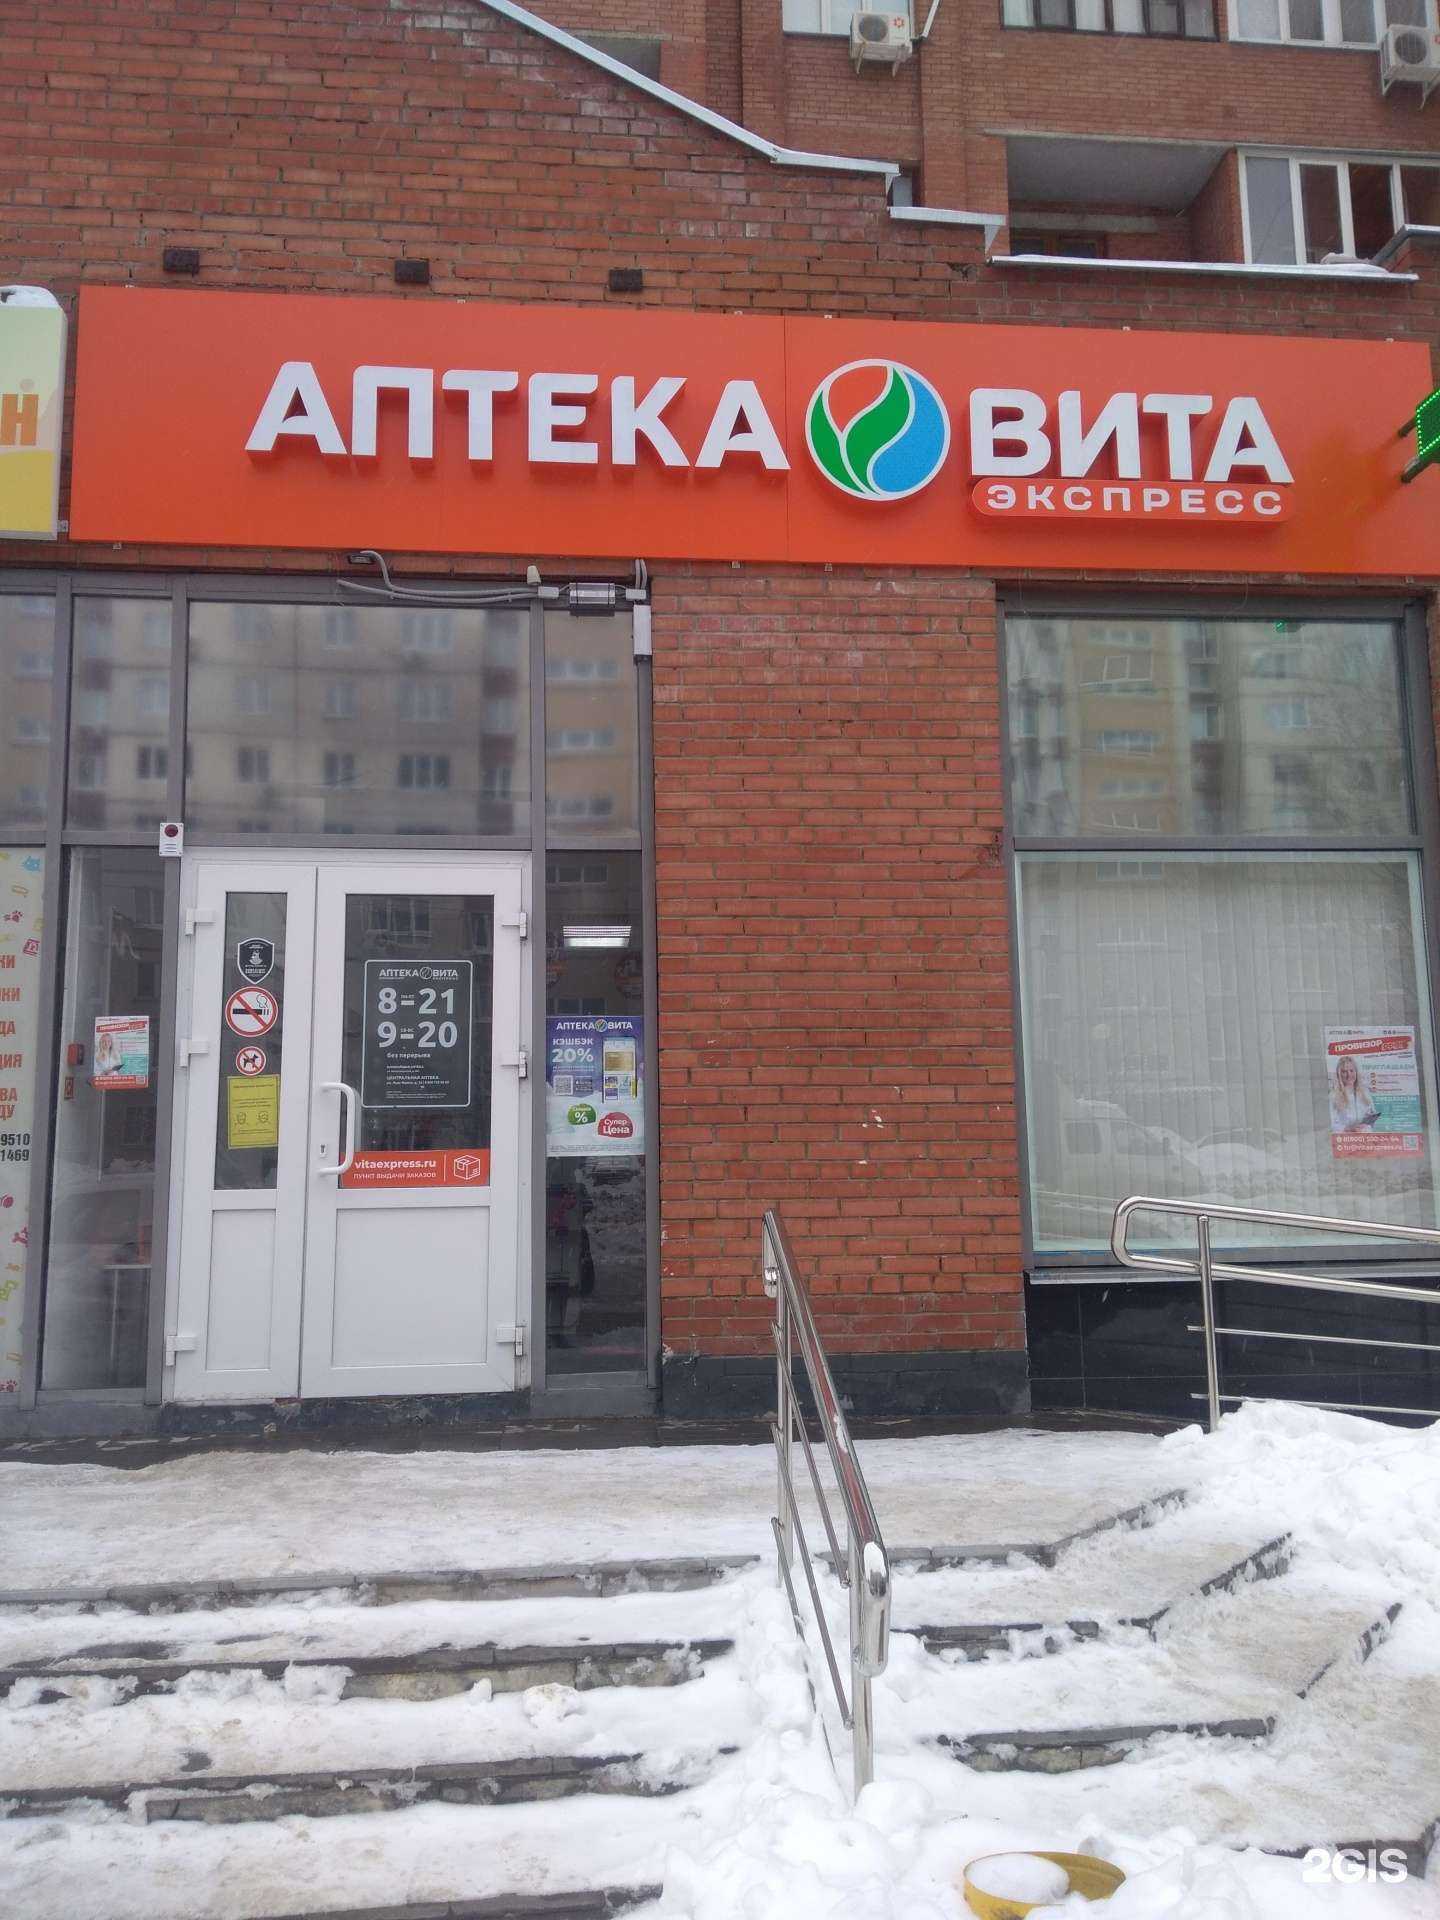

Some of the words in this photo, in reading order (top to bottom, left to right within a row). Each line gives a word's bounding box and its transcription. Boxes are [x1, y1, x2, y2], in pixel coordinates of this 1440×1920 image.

[245, 361, 790, 471] АПТЕКА
[969, 388, 1294, 483] ВИТА
[986, 484, 1282, 516] ЭКСПРЕСС
[378, 968, 419, 977] АПТЕКА
[433, 968, 458, 977] ВИТА
[556, 1021, 596, 1030] АПТЕКА
[607, 1021, 633, 1030] ВИТА
[552, 1038, 593, 1046] КЭШБЭК
[552, 1048, 594, 1062] 20%
[574, 1111, 588, 1123] %
[604, 1118, 628, 1127] Супер
[603, 1126, 630, 1135] Цена
[0, 1133, 31, 1147] 9510
[0, 1149, 30, 1162] 1469
[354, 1158, 436, 1170] vitaexpress.ru
[407, 1171, 436, 1179] ЗАКАЗОВ
